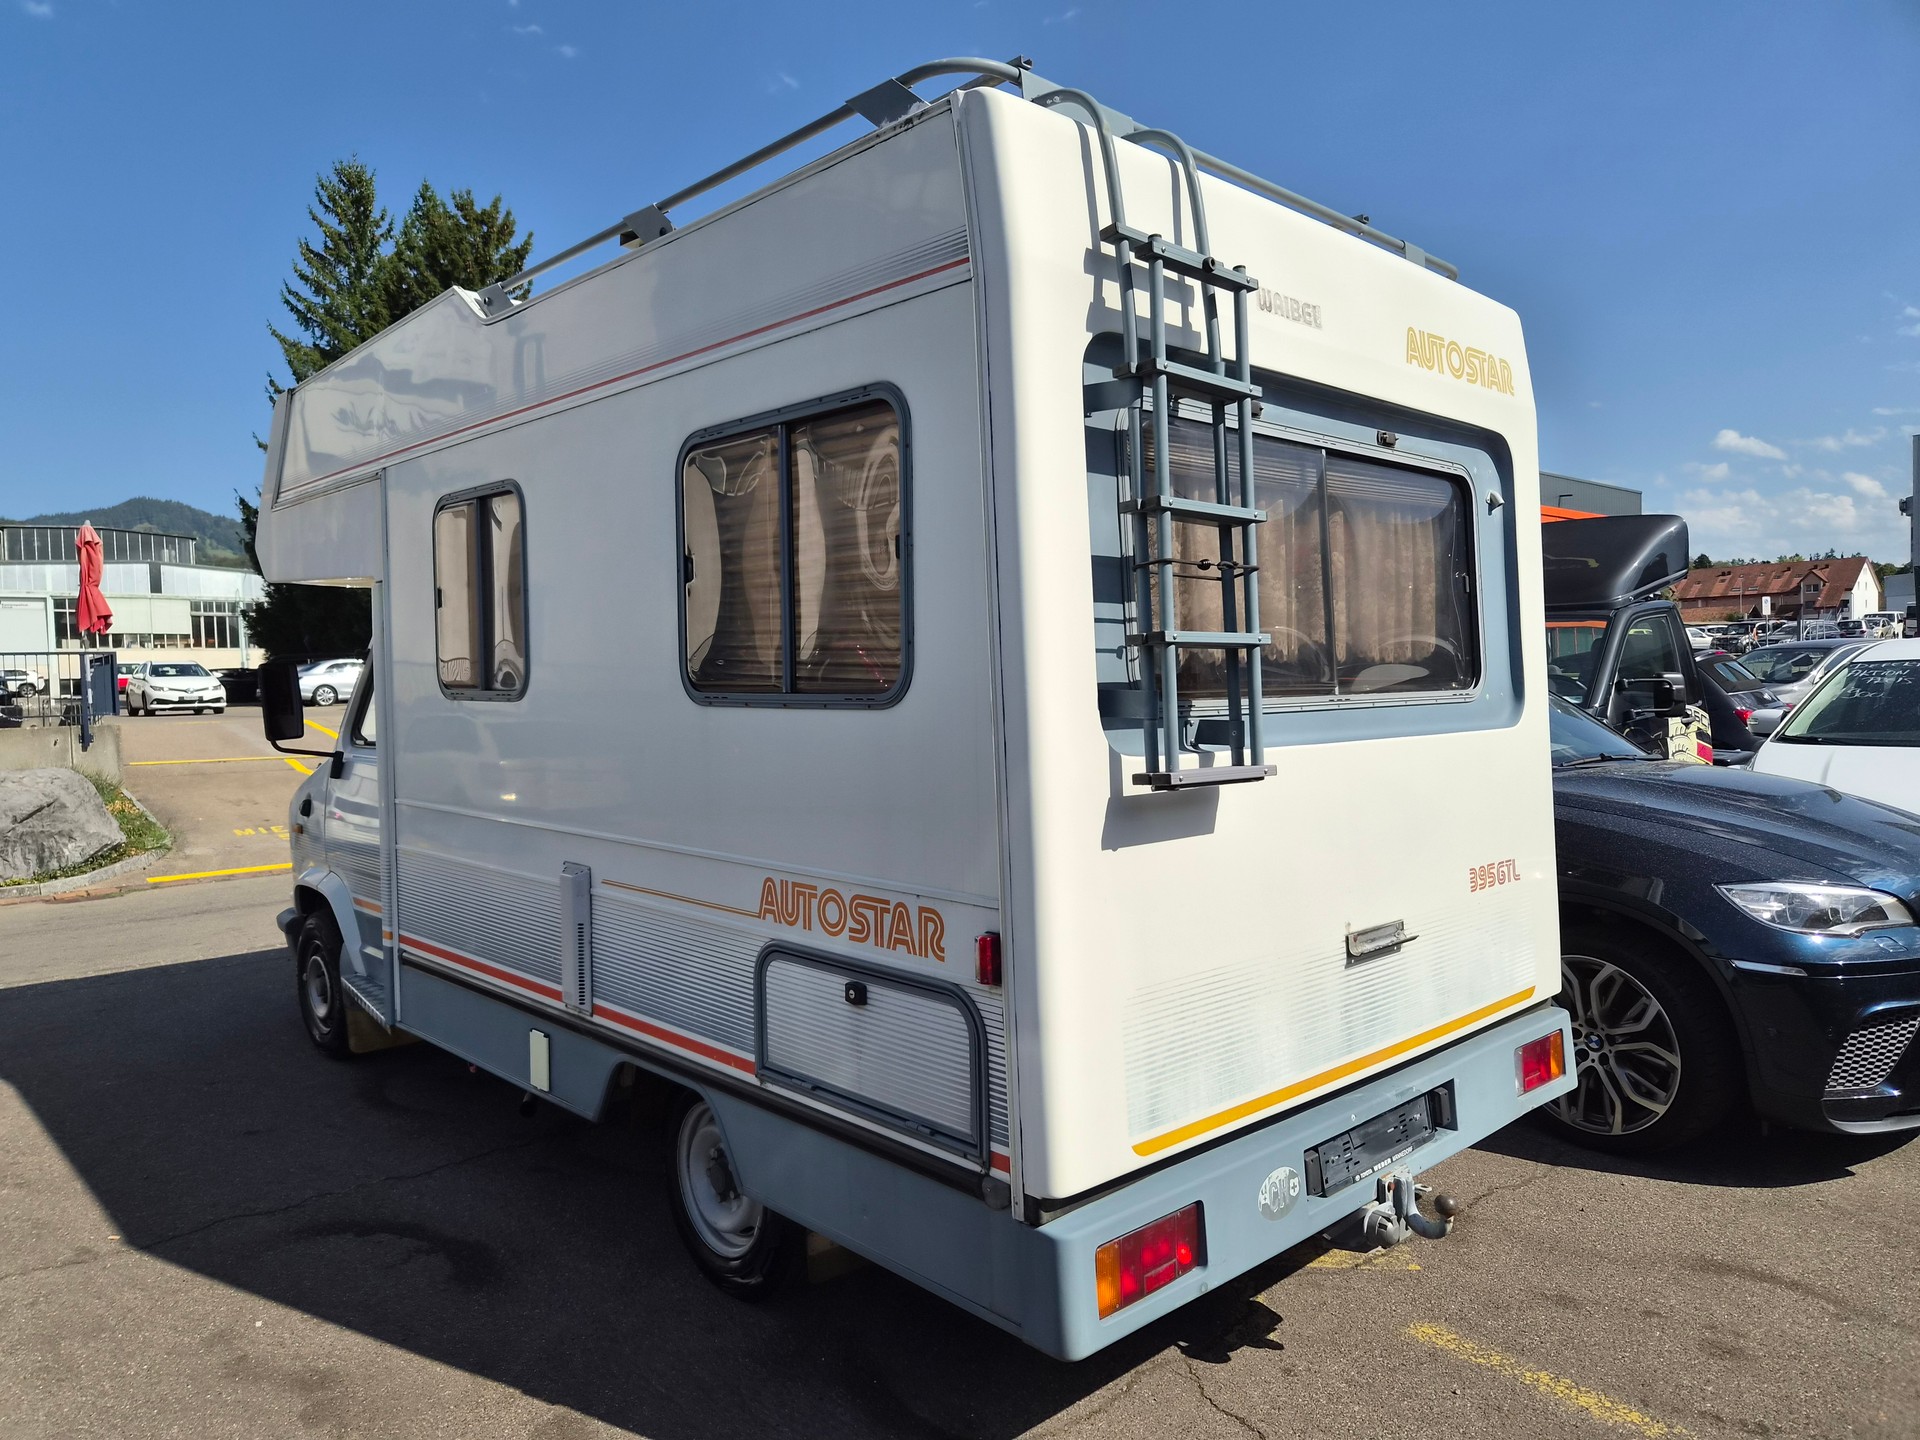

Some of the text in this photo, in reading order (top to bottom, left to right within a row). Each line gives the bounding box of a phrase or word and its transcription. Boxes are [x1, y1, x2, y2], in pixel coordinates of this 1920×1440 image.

[1406, 326, 1515, 396] AUTOSTAR
[1469, 858, 1521, 893] 395GTL
[758, 876, 945, 963] AUTOSTAR
